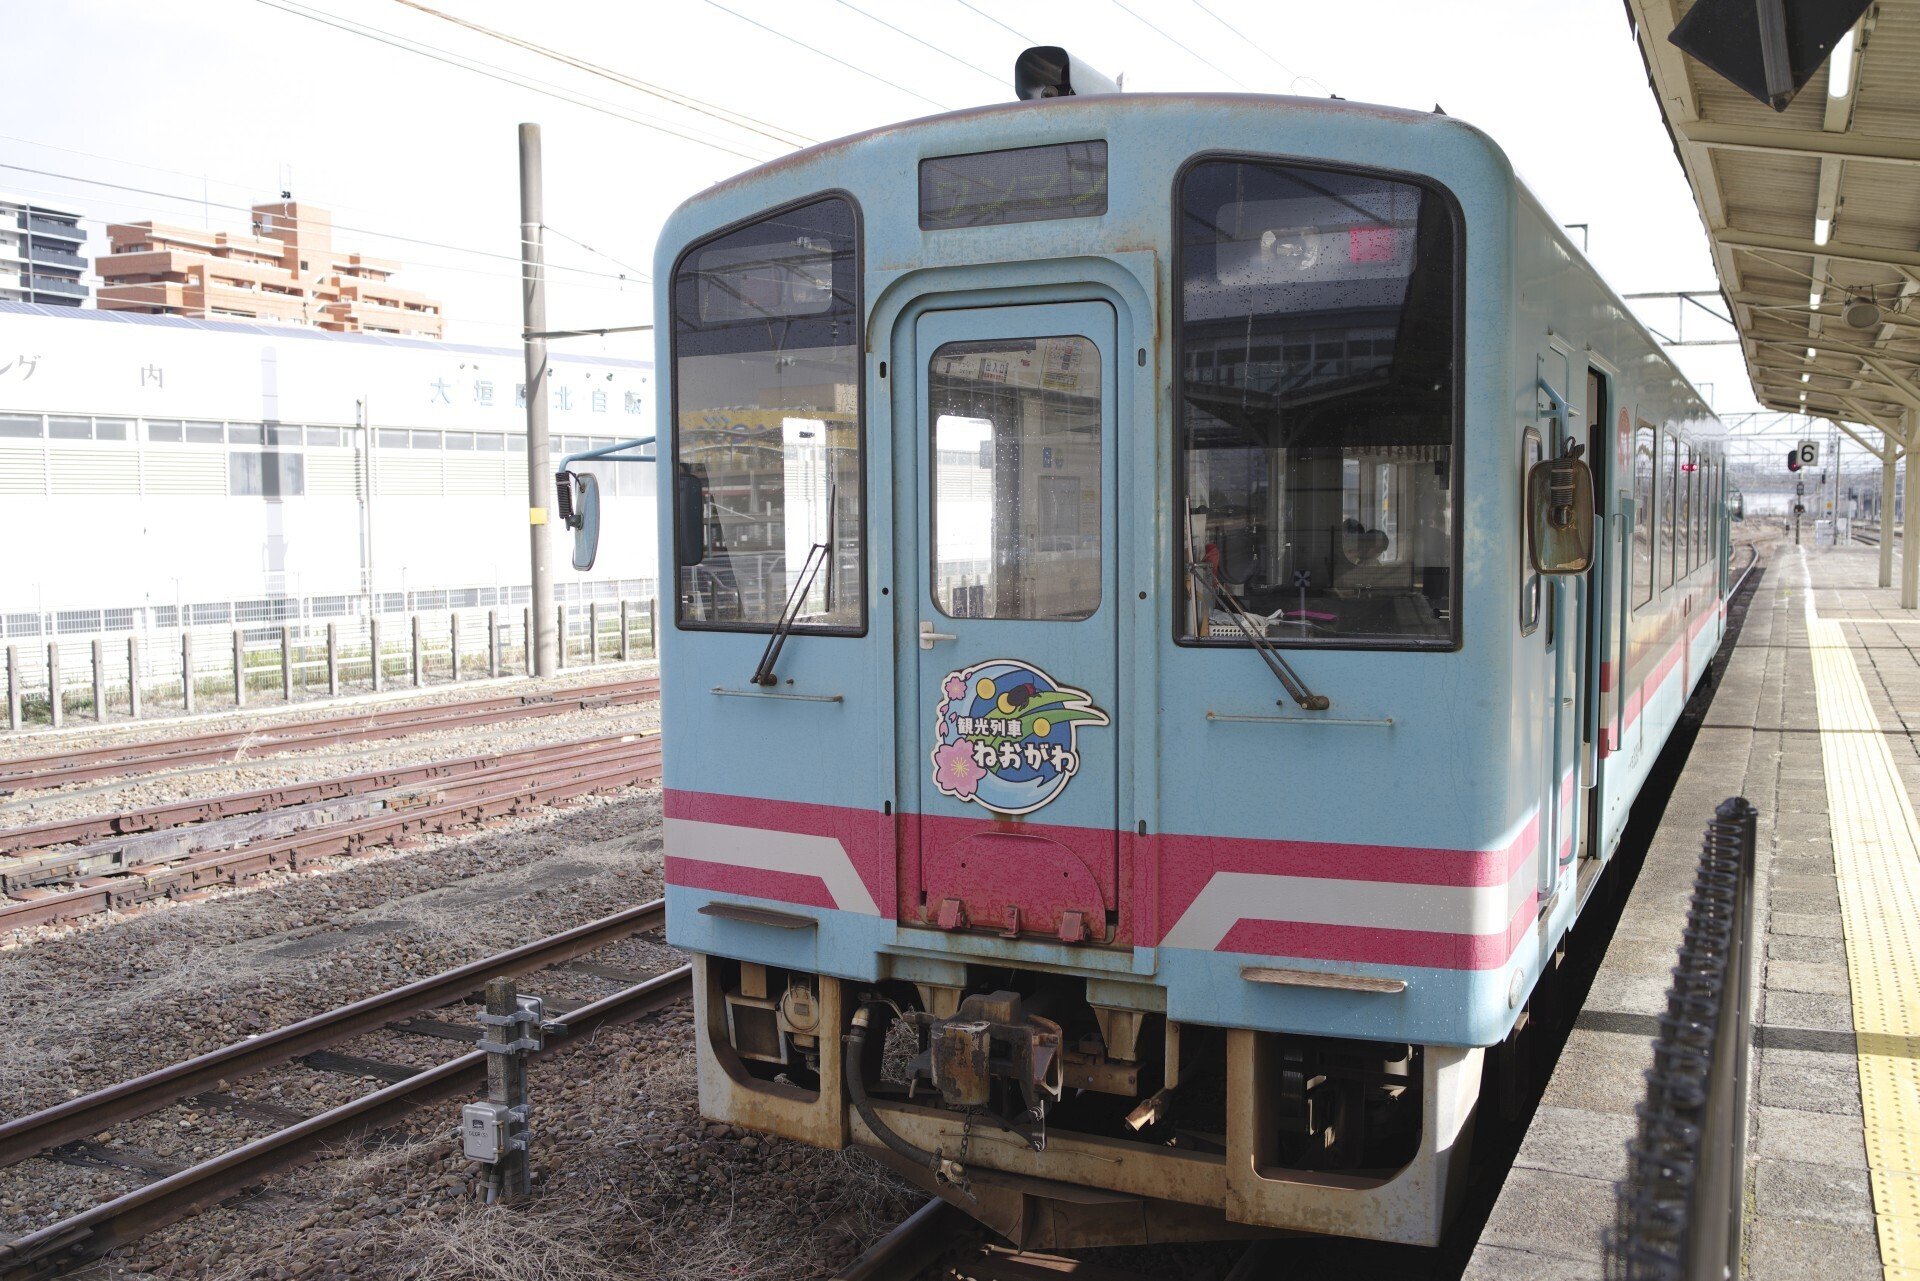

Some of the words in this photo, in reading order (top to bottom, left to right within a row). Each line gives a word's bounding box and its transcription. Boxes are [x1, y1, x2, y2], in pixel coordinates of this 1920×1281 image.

[140, 363, 164, 389] 内
[1801, 444, 1815, 463] 6
[956, 715, 1023, 738] 観光列車
[973, 740, 1077, 773] ねおがわ
